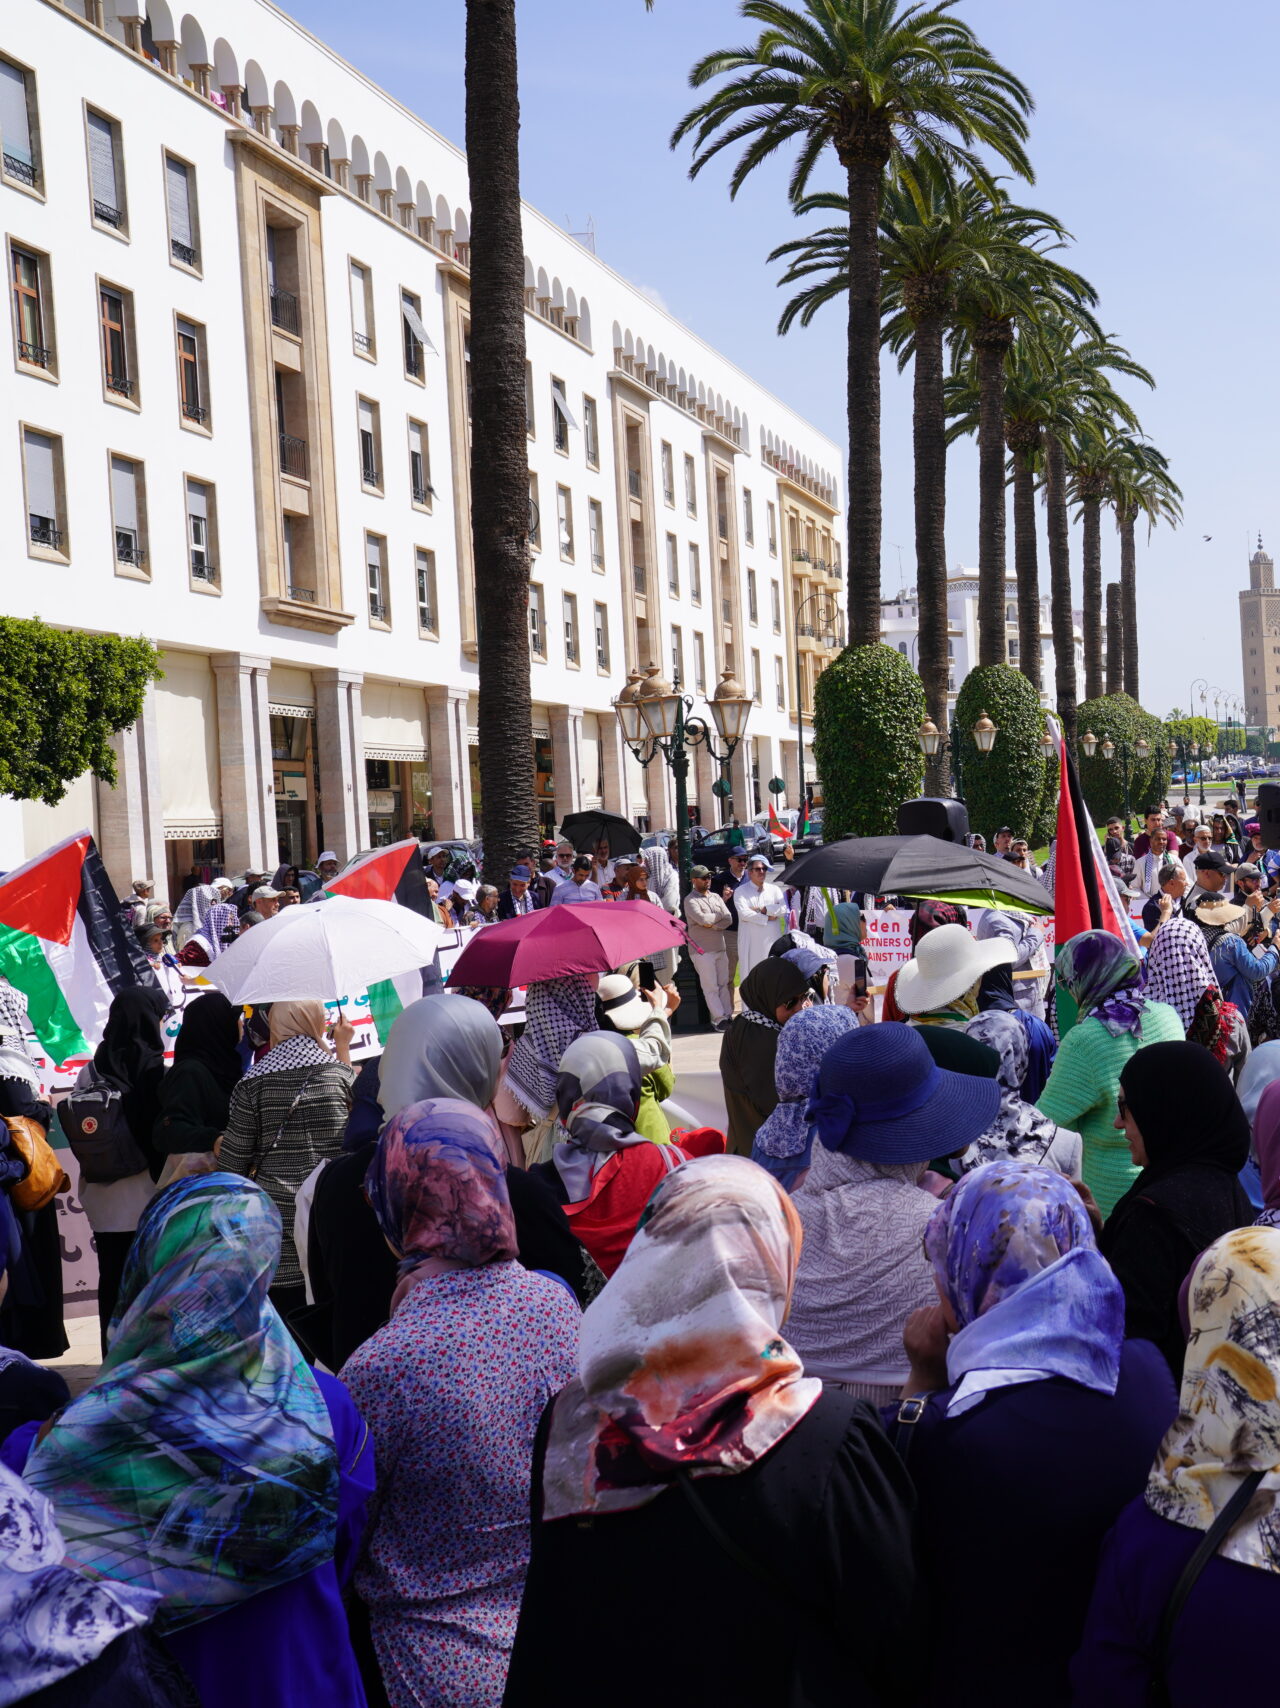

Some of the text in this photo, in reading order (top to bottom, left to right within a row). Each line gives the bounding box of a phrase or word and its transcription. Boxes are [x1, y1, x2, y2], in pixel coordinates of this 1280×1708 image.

[860, 937, 902, 948] ARTNERS
[867, 952, 913, 963] AINST TH
